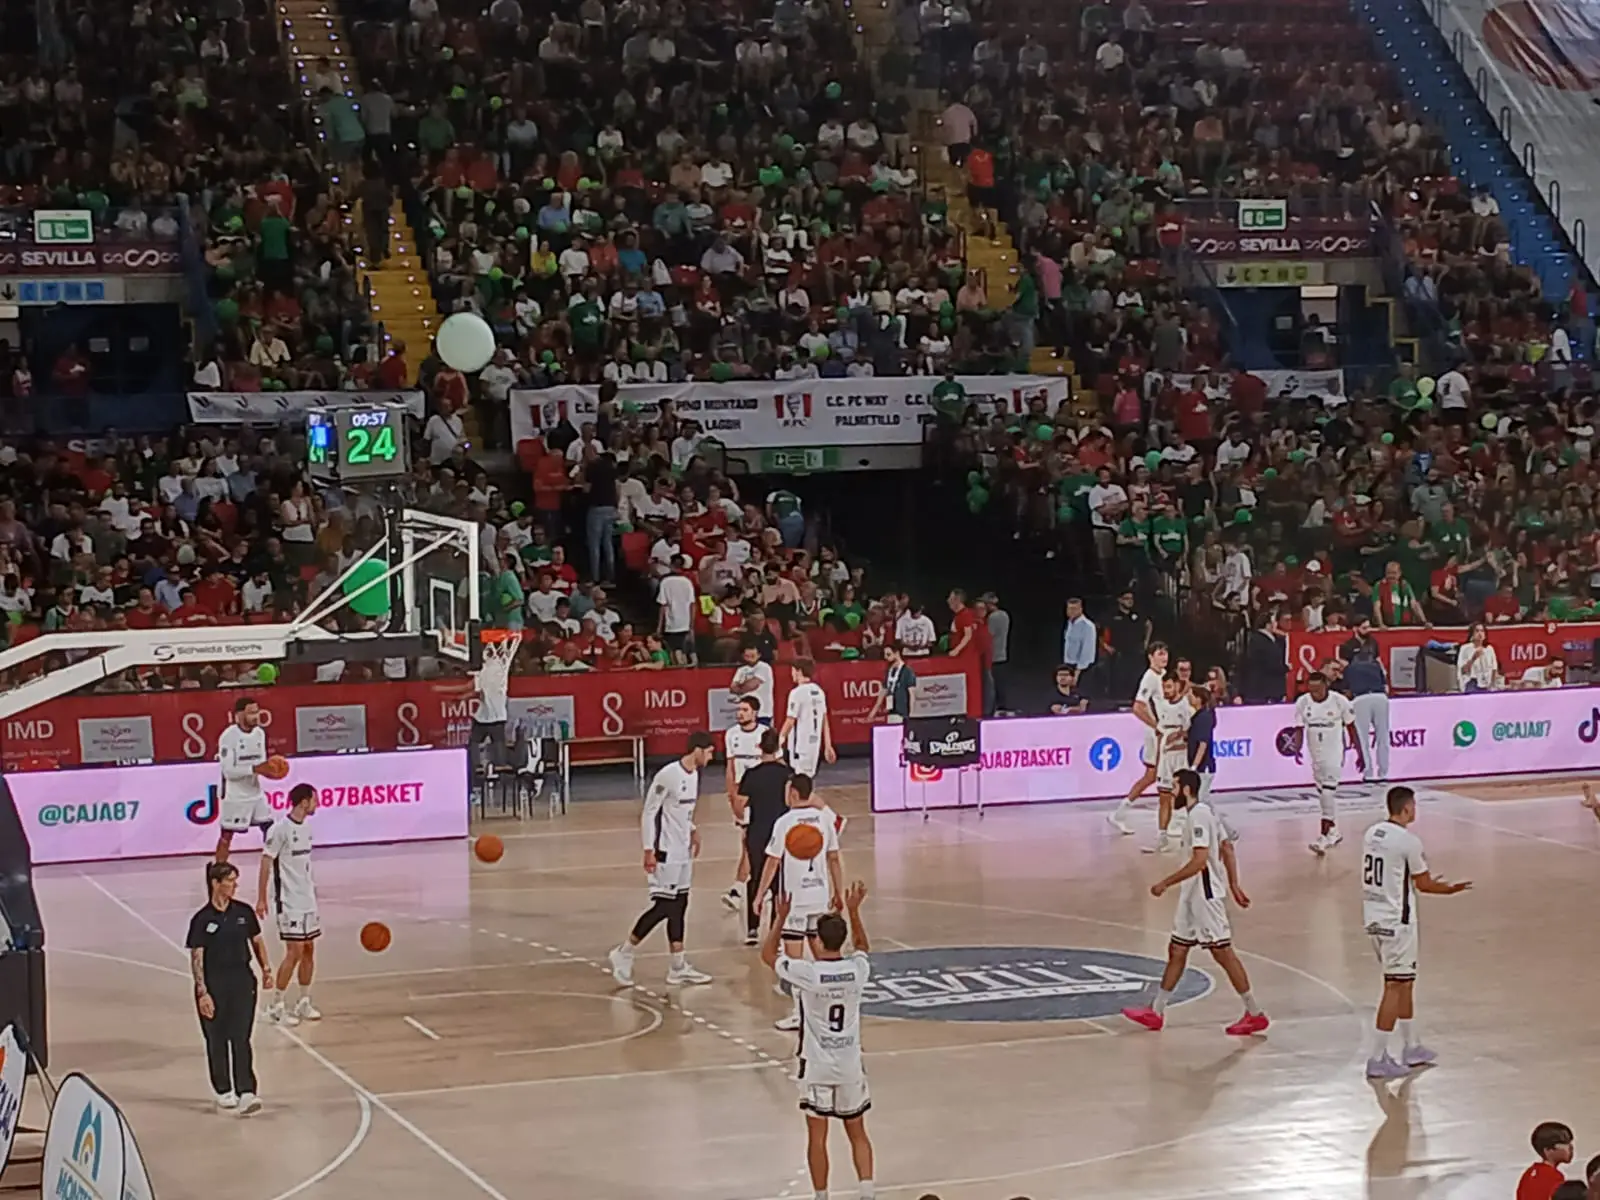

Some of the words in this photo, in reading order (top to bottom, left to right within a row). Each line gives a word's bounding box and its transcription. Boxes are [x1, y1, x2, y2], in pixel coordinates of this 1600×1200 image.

[1239, 238, 1301, 251] SEVILLA
[22, 251, 96, 266] SEVILLA
[352, 411, 388, 427] 09:57
[347, 426, 397, 464] 24
[1510, 643, 1548, 661] IMD
[644, 689, 686, 709] IMD
[843, 680, 883, 699] IMD
[441, 699, 481, 718] IMD
[7, 719, 54, 739] IMD
[1491, 720, 1552, 742] @CAJA87
[38, 800, 140, 827] @CAJA87
[1363, 853, 1384, 887] 20
[859, 963, 1163, 1002] SEVILLA
[828, 1003, 845, 1032] 9
